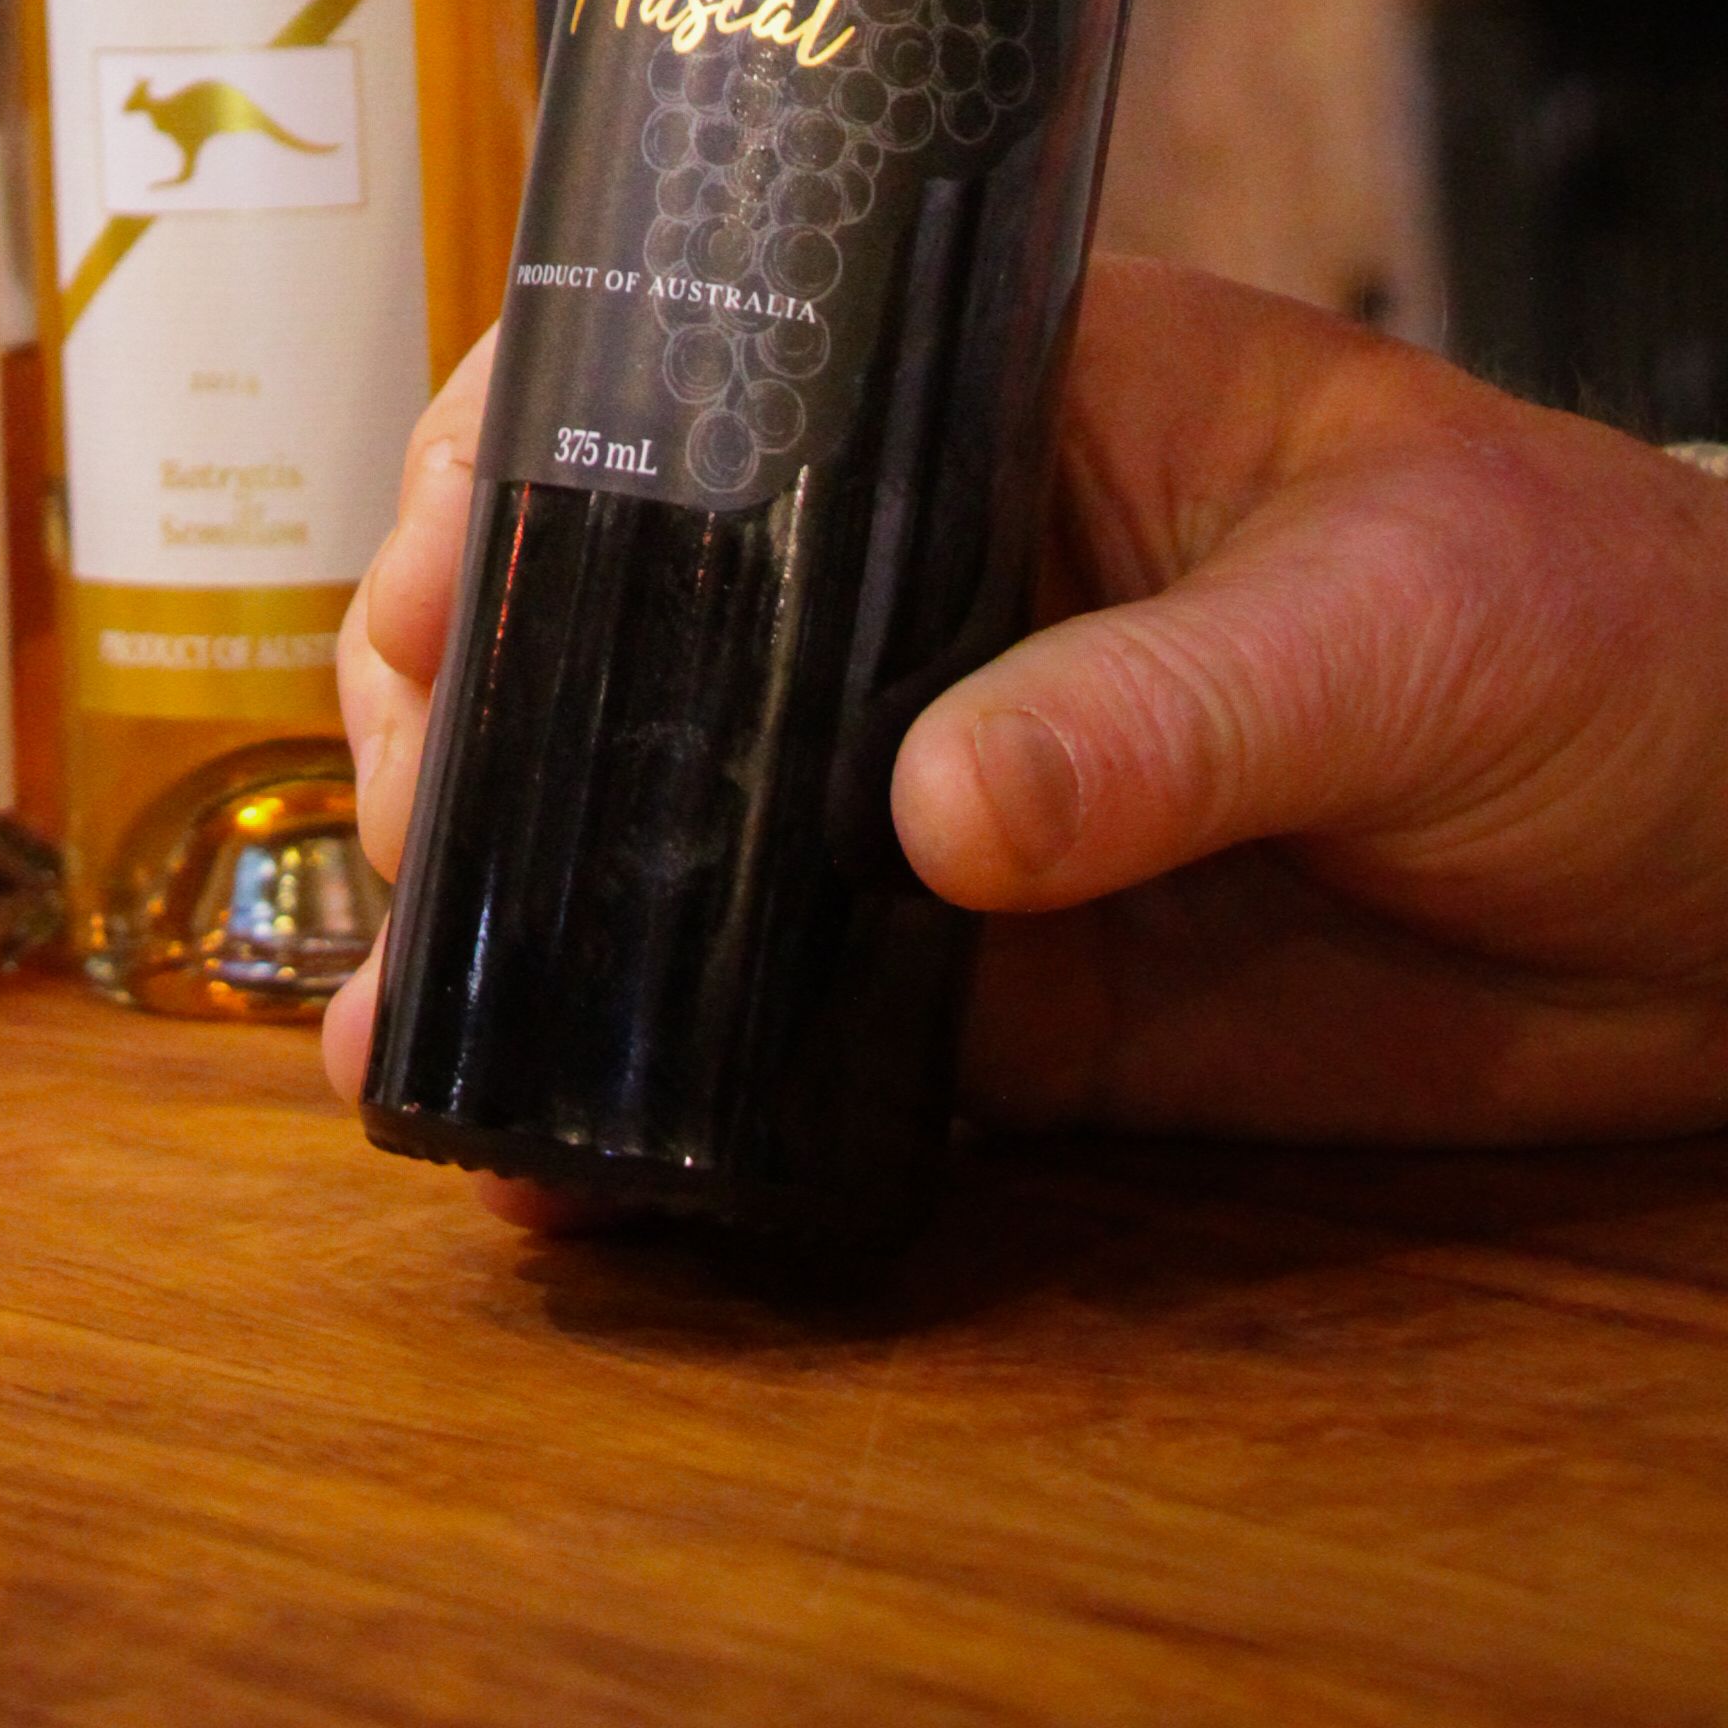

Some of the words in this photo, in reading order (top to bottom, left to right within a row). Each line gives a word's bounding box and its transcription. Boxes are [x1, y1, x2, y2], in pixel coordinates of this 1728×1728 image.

[516, 262, 599, 291] PRODUCT
[604, 269, 640, 293] OF
[648, 274, 818, 325] AUSTRALIA
[553, 427, 600, 468] 375
[606, 435, 659, 476] mL
